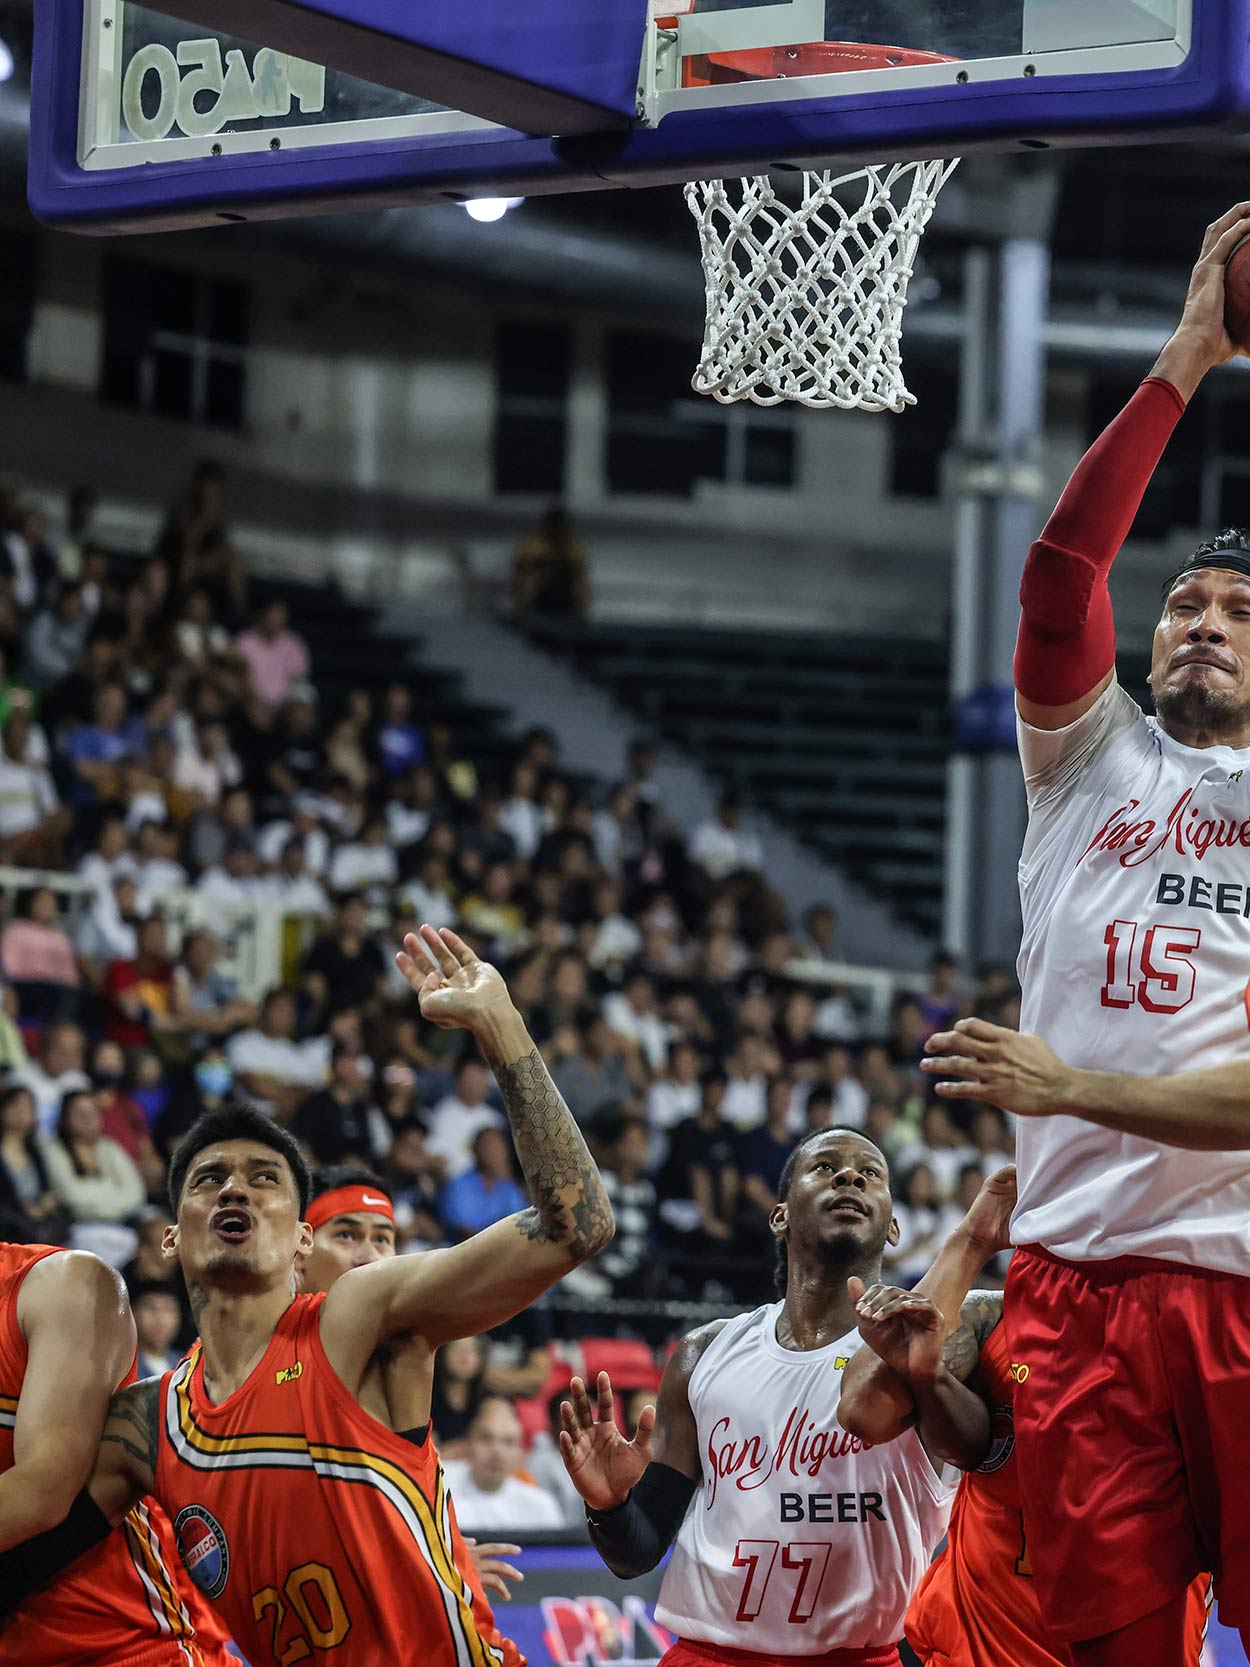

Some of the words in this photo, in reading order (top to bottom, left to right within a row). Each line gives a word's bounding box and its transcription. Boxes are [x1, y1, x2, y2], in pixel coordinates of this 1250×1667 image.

[1076, 799, 1157, 868] San
[1101, 920, 1201, 1014] 15
[707, 1416, 768, 1511] San
[780, 1492, 887, 1523] BEER
[251, 1561, 352, 1667] 20
[732, 1539, 832, 1623] 77
